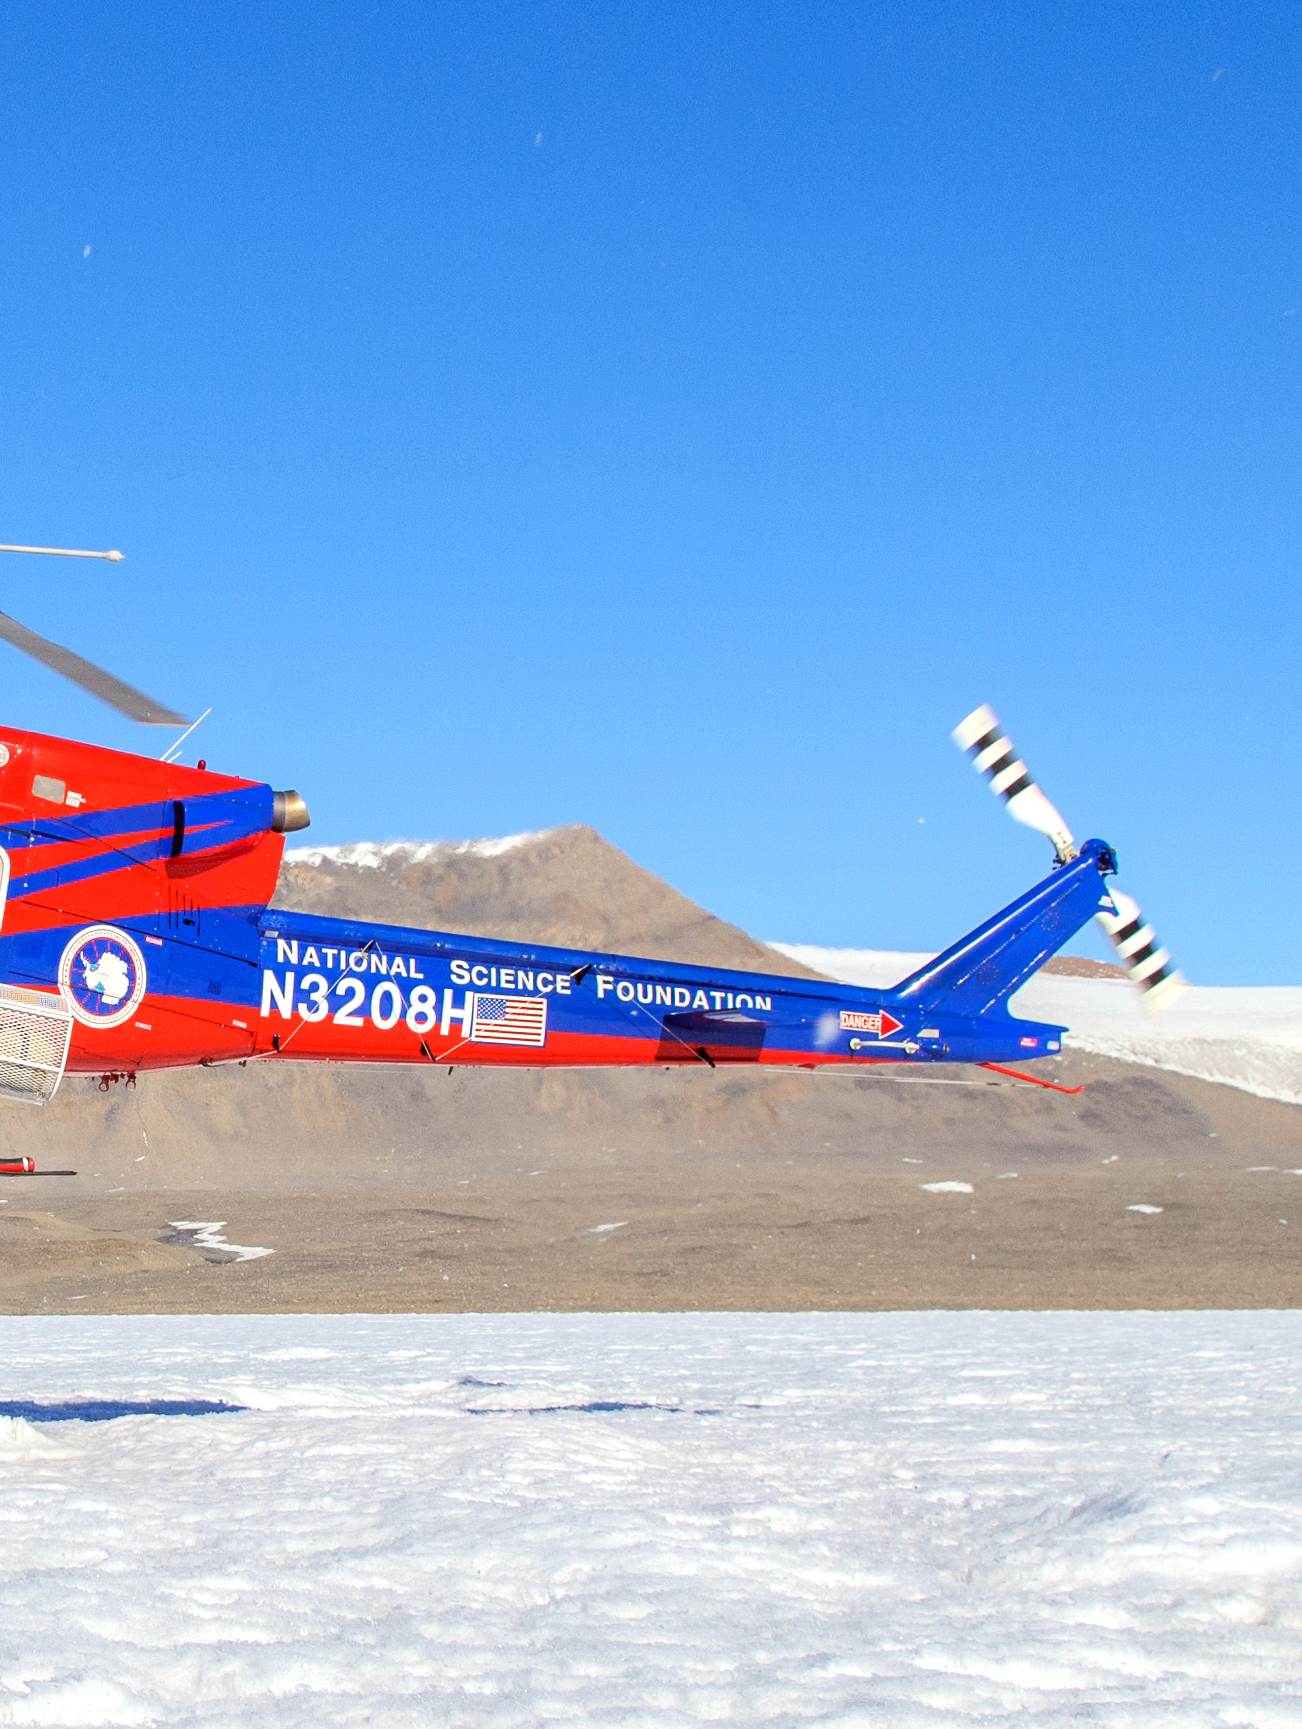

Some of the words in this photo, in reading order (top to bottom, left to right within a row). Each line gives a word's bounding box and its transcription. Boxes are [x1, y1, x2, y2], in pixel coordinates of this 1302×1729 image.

[260, 968, 474, 1038] N3208H
[277, 938, 424, 979] NATIONAL
[450, 959, 571, 995] SCIENCE
[596, 974, 771, 1011] FOUNDATION
[841, 1013, 882, 1031] DANGER
